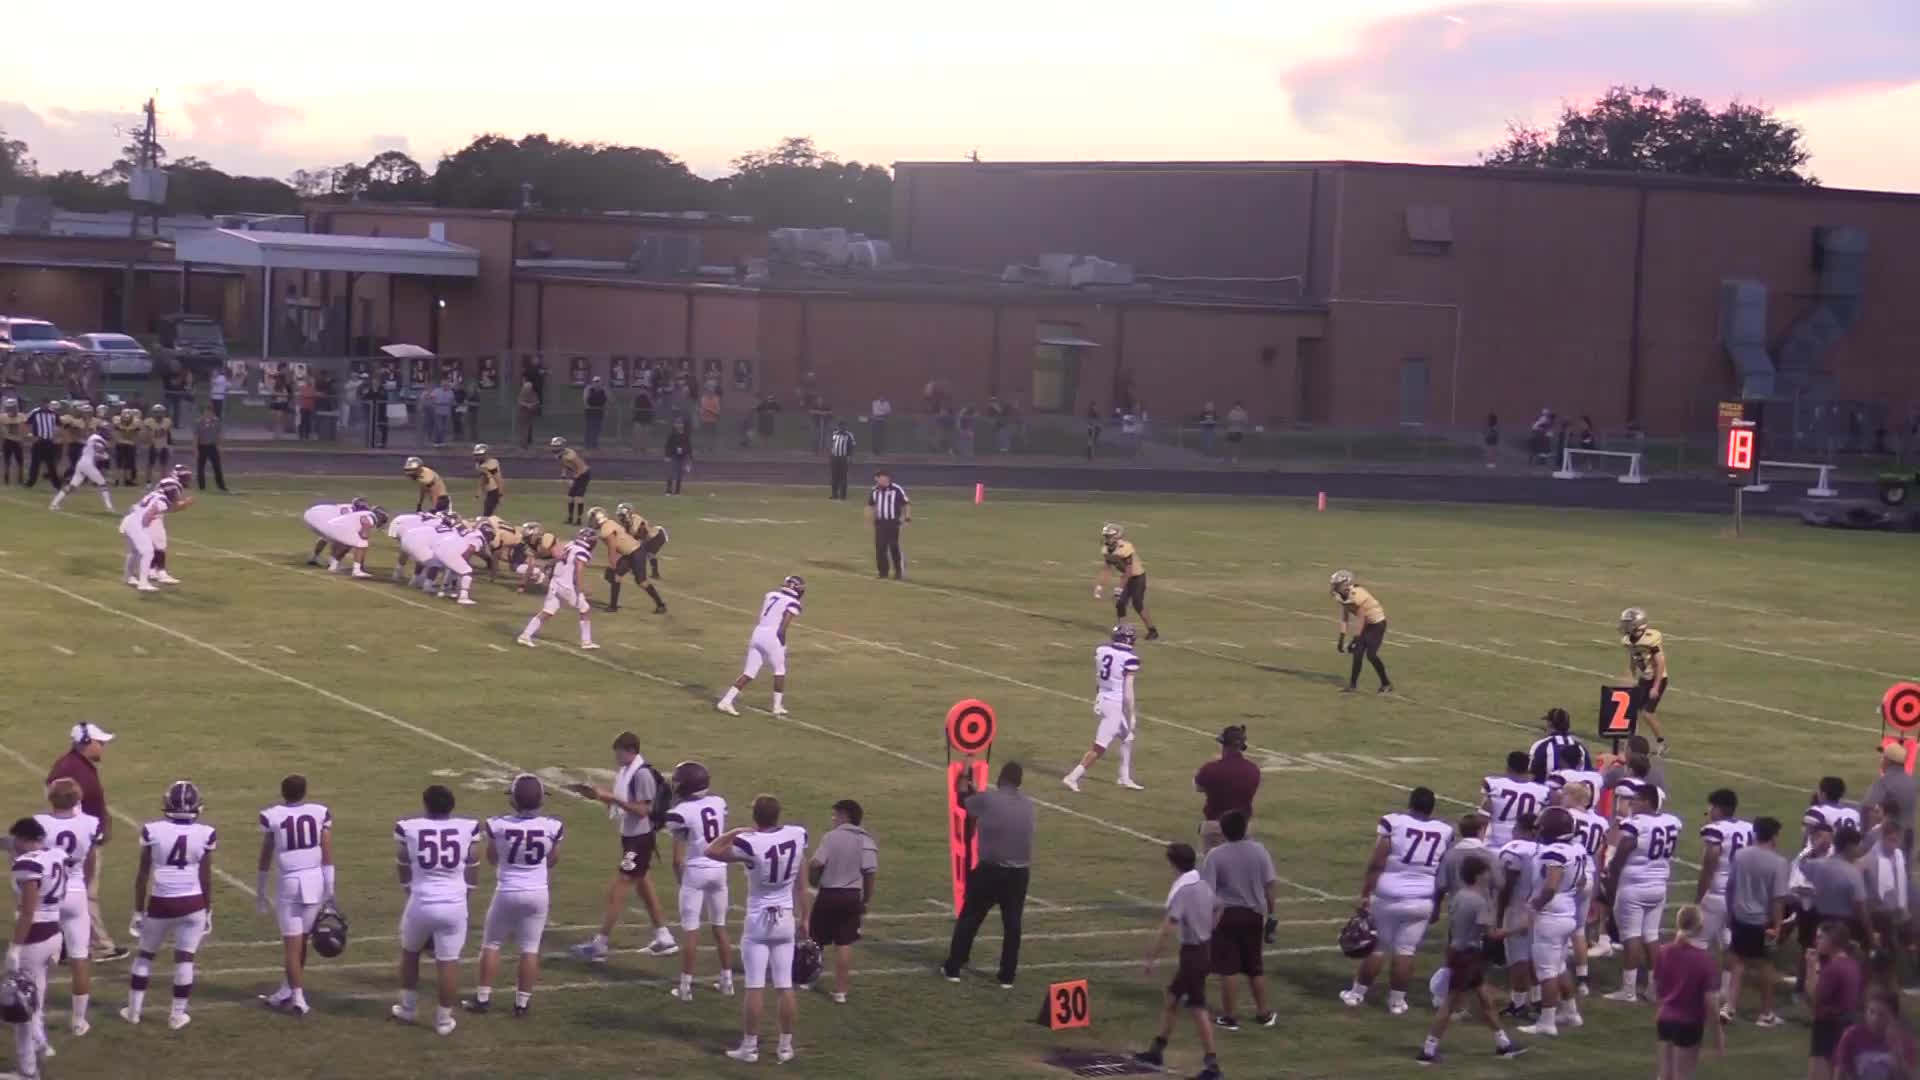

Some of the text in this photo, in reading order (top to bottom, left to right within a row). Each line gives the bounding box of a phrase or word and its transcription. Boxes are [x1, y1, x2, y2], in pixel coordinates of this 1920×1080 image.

[1728, 429, 1753, 469] 18
[1100, 654, 1113, 680] 3
[1609, 690, 1631, 729] 2
[1499, 788, 1536, 821] 70
[280, 814, 318, 850] 10
[700, 806, 720, 844] 6
[1576, 818, 1604, 855] 50
[1647, 825, 1678, 860] 65
[166, 834, 188, 869] 4
[417, 828, 461, 869] 55
[505, 829, 545, 865] 75
[764, 839, 797, 883] 17
[1402, 827, 1442, 867] 77
[1055, 985, 1087, 1024] 30
